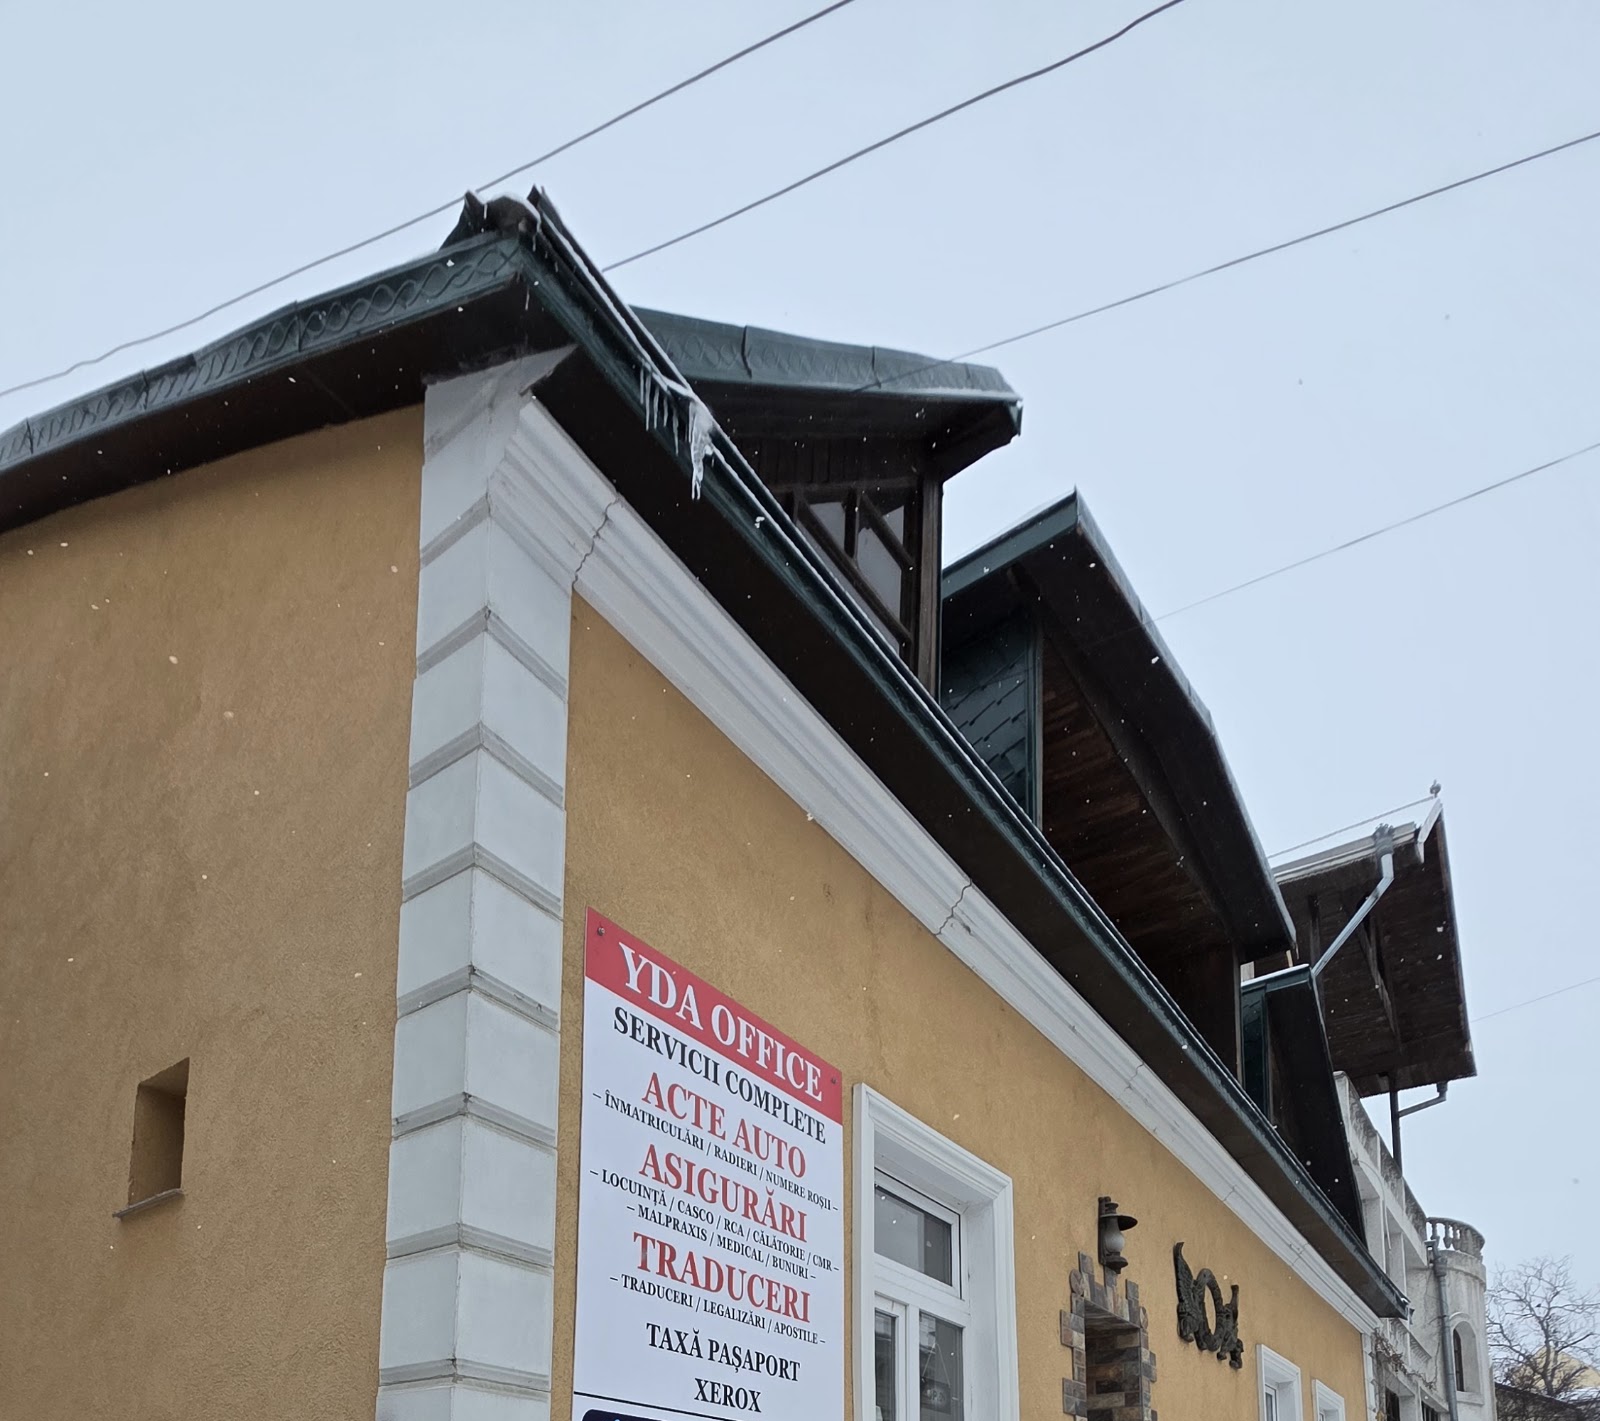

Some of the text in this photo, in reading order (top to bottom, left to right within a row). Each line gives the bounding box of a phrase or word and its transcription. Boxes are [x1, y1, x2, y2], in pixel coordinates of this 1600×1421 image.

[618, 941, 823, 1102] YDA OFFICE
[613, 1006, 826, 1145] SERVICII COMPLETE
[641, 1072, 806, 1178] ACTE AUTO
[604, 1089, 704, 1151] ÎNMATRICULĂRI
[714, 1144, 758, 1176] RADIERI
[765, 1170, 806, 1199] NUMERE
[638, 1143, 808, 1243] ASIGURĂRI
[602, 1169, 667, 1206] LOCUINȚĂ
[677, 1199, 714, 1225] CASCO
[724, 1218, 745, 1238] RCA
[752, 1230, 806, 1261] CĂLĂTORIE
[812, 1254, 833, 1272] CMR
[638, 1204, 708, 1242] MALPRAXIS
[716, 1234, 764, 1263] MEDICAL
[772, 1255, 809, 1280] BUNURI
[621, 1273, 694, 1308] TRADUCERI
[703, 1299, 766, 1330] LEGALIZĂRI
[773, 1321, 819, 1345] APOSTILE
[633, 1231, 811, 1324] TRADUCERI
[646, 1323, 801, 1382] TAXĂ PAȘAPORT
[693, 1377, 762, 1413] XEROX
